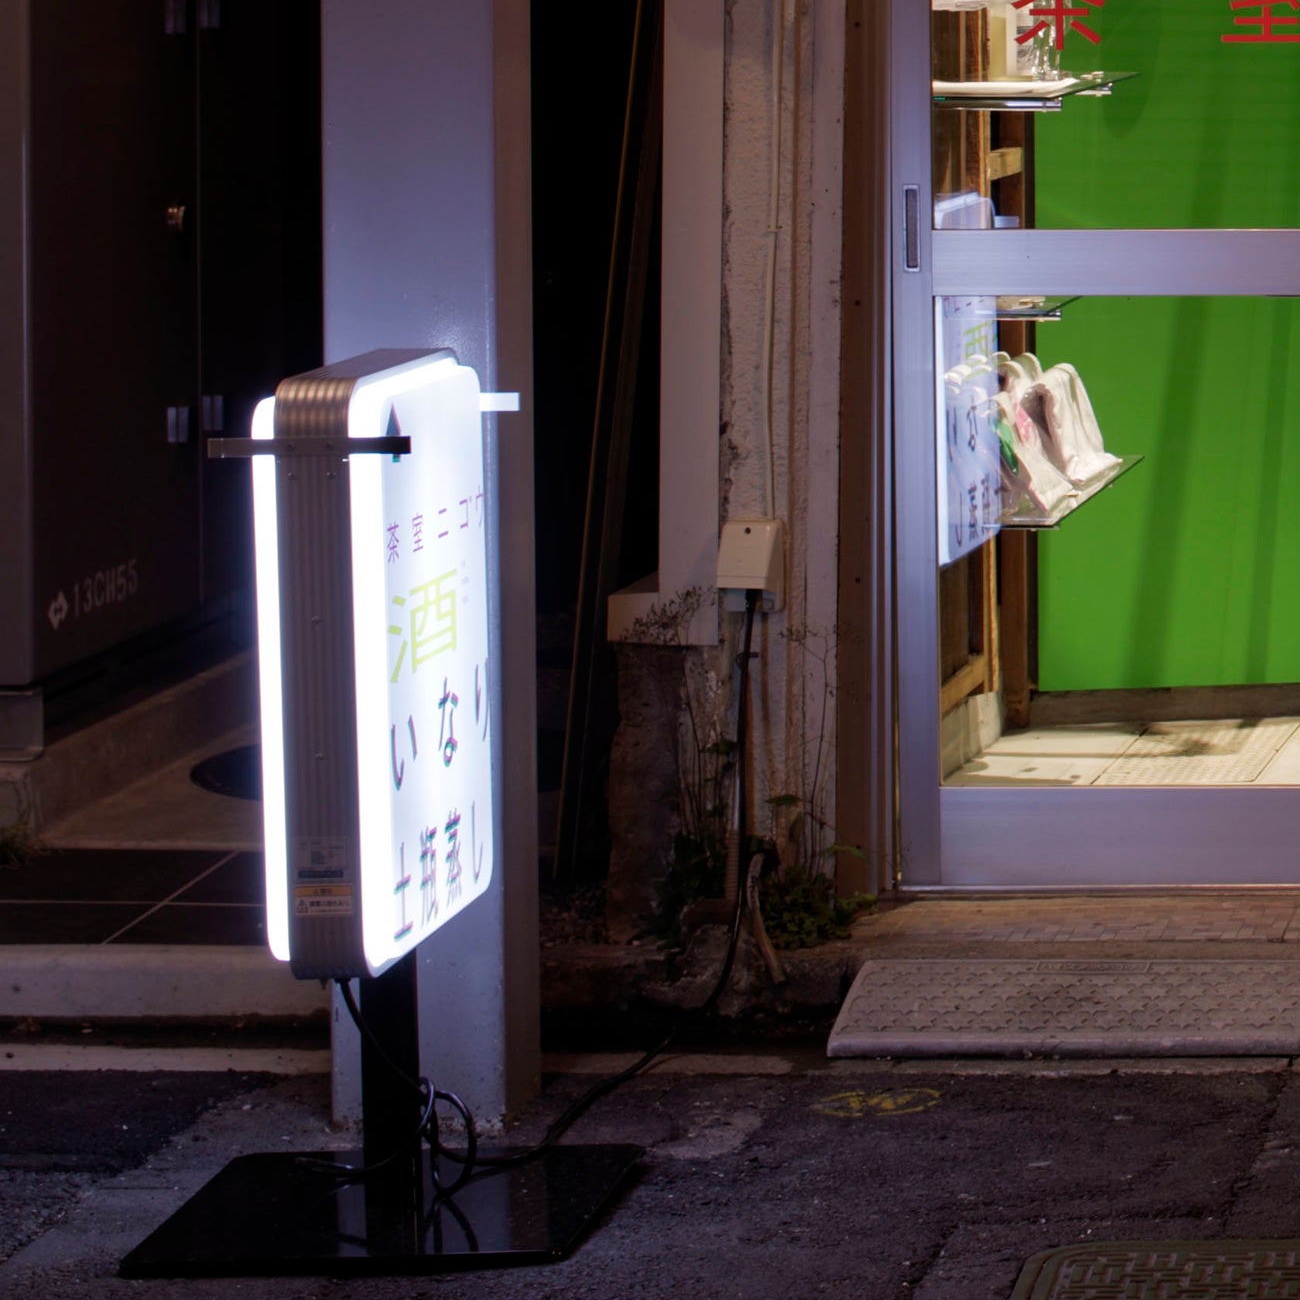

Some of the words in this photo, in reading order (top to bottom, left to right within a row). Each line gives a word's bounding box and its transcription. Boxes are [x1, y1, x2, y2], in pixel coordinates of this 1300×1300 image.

[387, 567, 459, 684] 酒
[390, 656, 491, 791] いなり
[393, 798, 484, 941] 土瓶蒸し
